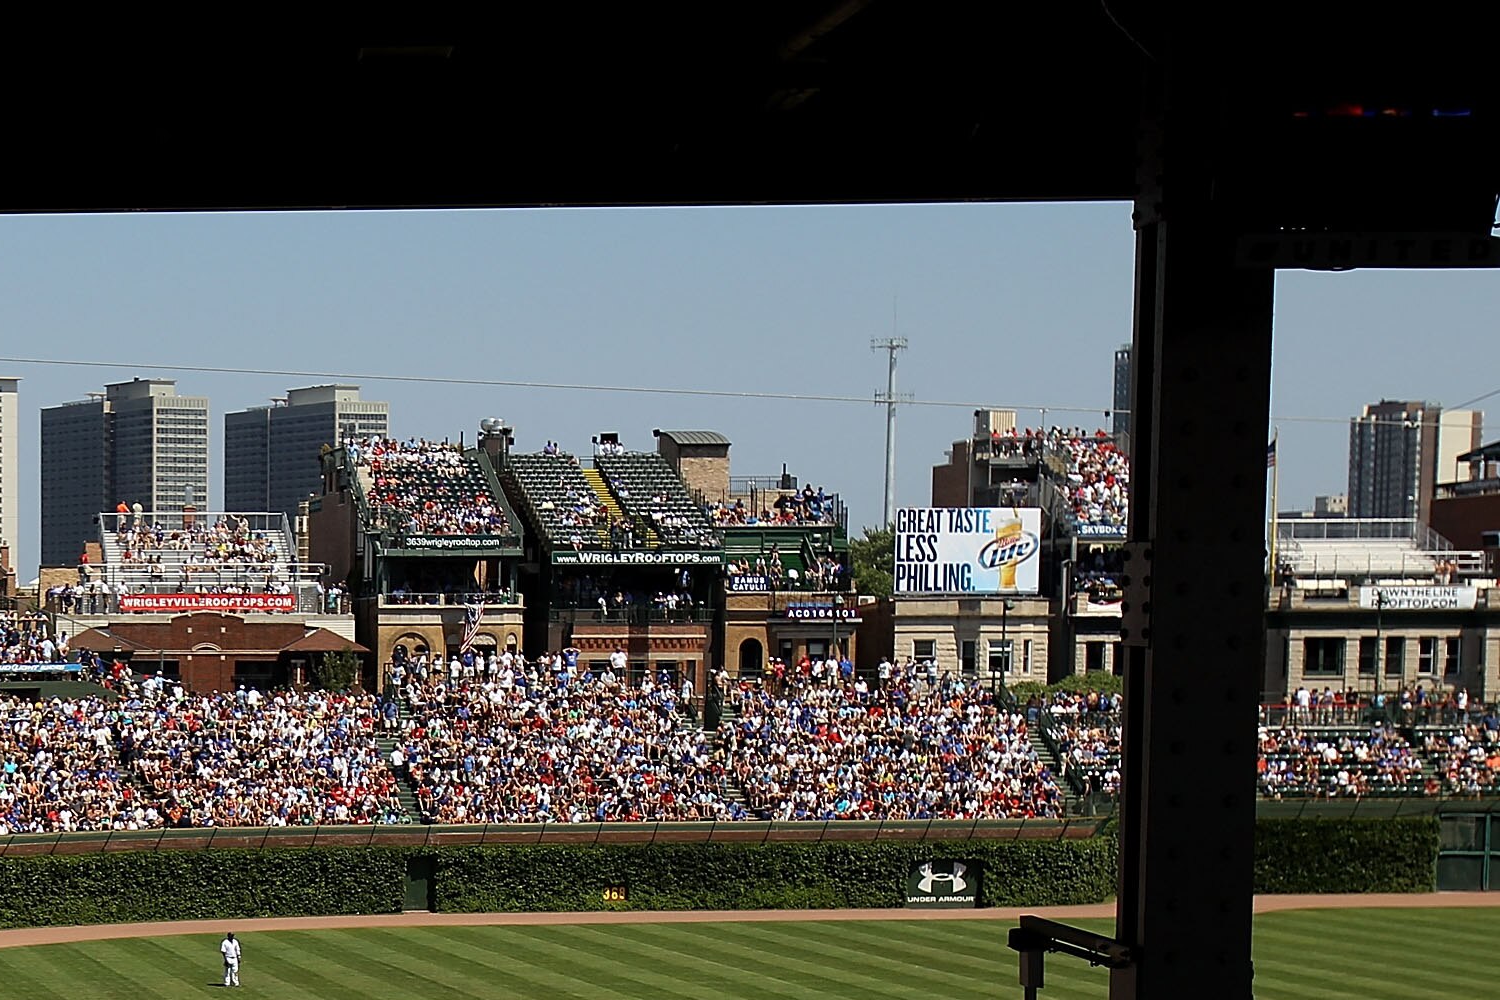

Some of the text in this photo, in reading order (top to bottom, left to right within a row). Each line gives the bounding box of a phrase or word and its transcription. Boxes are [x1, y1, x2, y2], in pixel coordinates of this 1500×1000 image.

[897, 509, 994, 533] GREAT TASTE.
[1082, 525, 1117, 534] SKYBOX
[406, 538, 499, 547] 3639wrigleyrooftop.com
[896, 535, 937, 562] LESS
[989, 542, 1030, 568] Lite
[896, 563, 976, 592] PHILLING.
[1434, 589, 1457, 597] LINE
[124, 597, 292, 606] WRIGLEYVILLEROOFTOPS.COM
[12, 664, 40, 672] LIGHT
